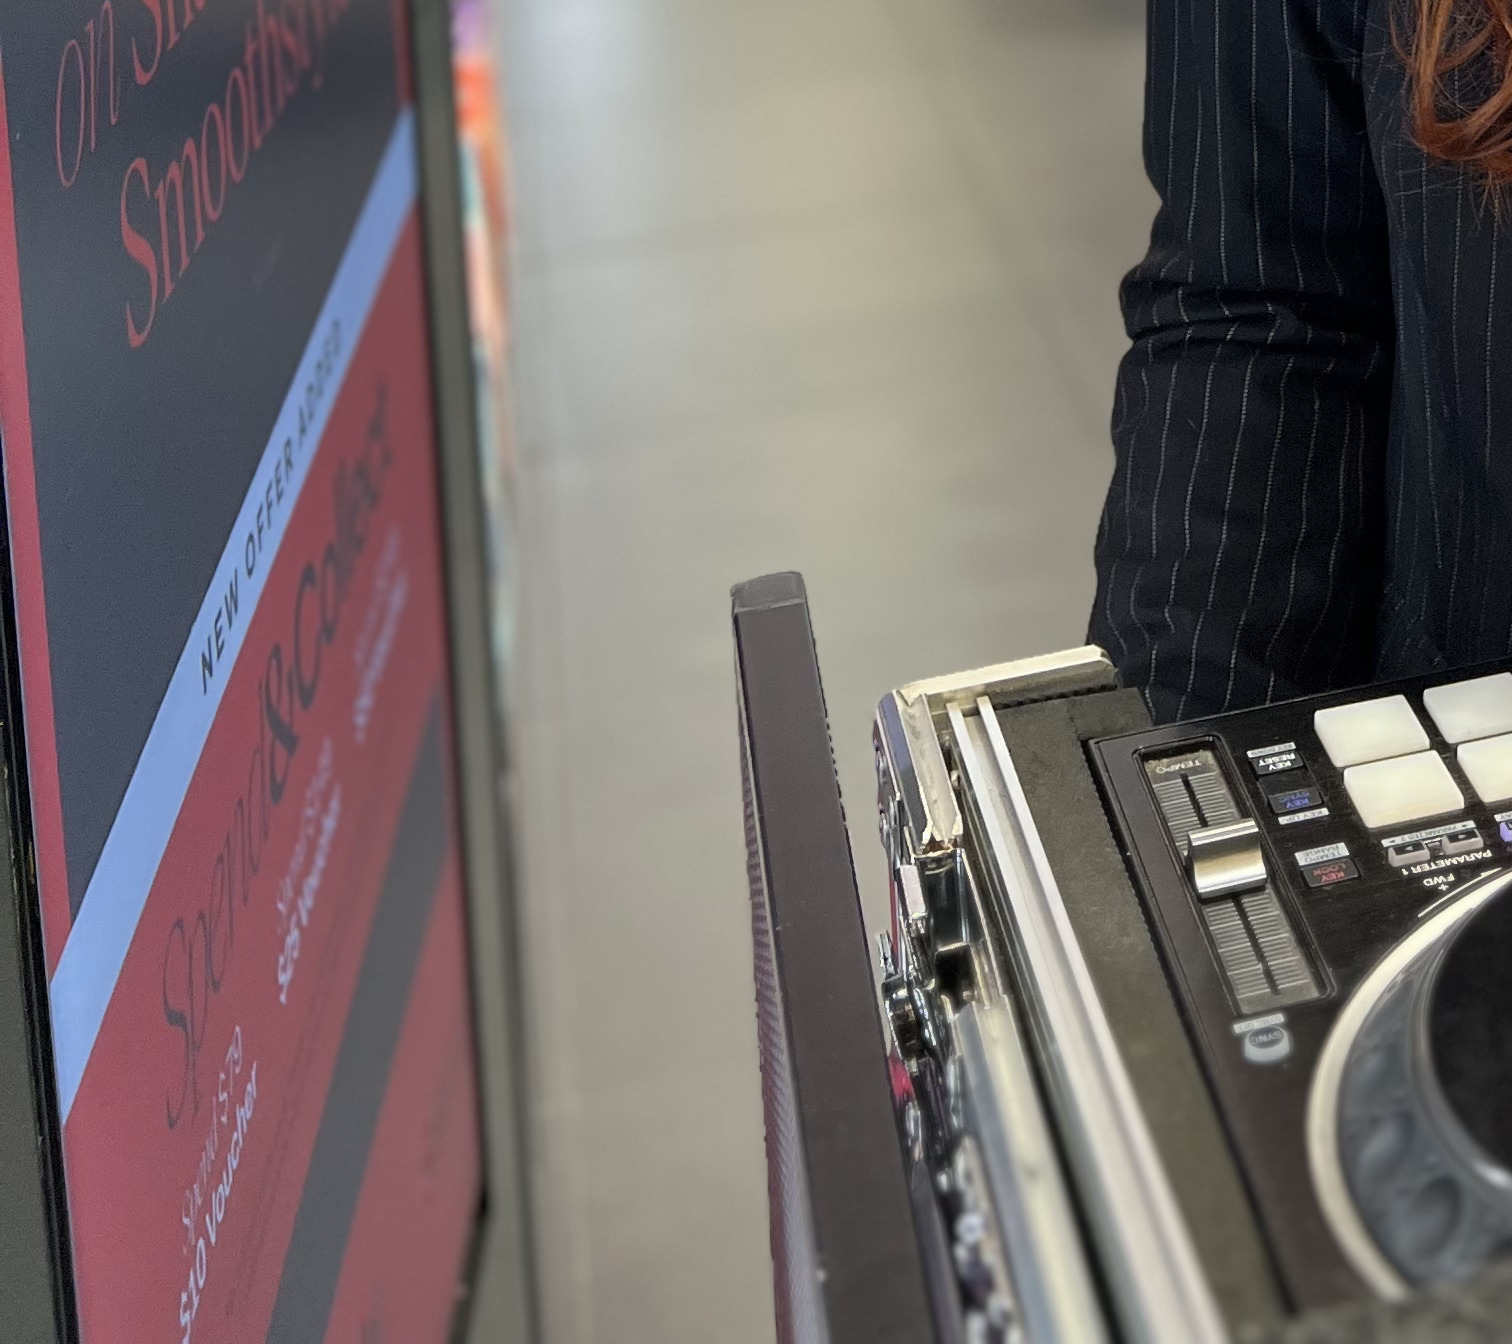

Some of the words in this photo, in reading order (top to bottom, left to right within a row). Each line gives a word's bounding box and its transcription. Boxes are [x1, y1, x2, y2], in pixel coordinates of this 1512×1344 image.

[55, 0, 118, 188] on
[199, 575, 241, 695] NEW
[244, 445, 296, 580] OFFER
[1155, 759, 1202, 774] TEMPO
[1259, 753, 1296, 767] RESET
[1269, 761, 1292, 772] KEY
[1286, 798, 1310, 809] KEY
[1411, 849, 1493, 874] PARAMETER
[1313, 864, 1346, 878] LOCK
[1320, 870, 1345, 883] KEY
[1422, 872, 1455, 887] FWD
[1250, 1031, 1282, 1046] SYNC
[205, 1061, 261, 1247] Voucher
